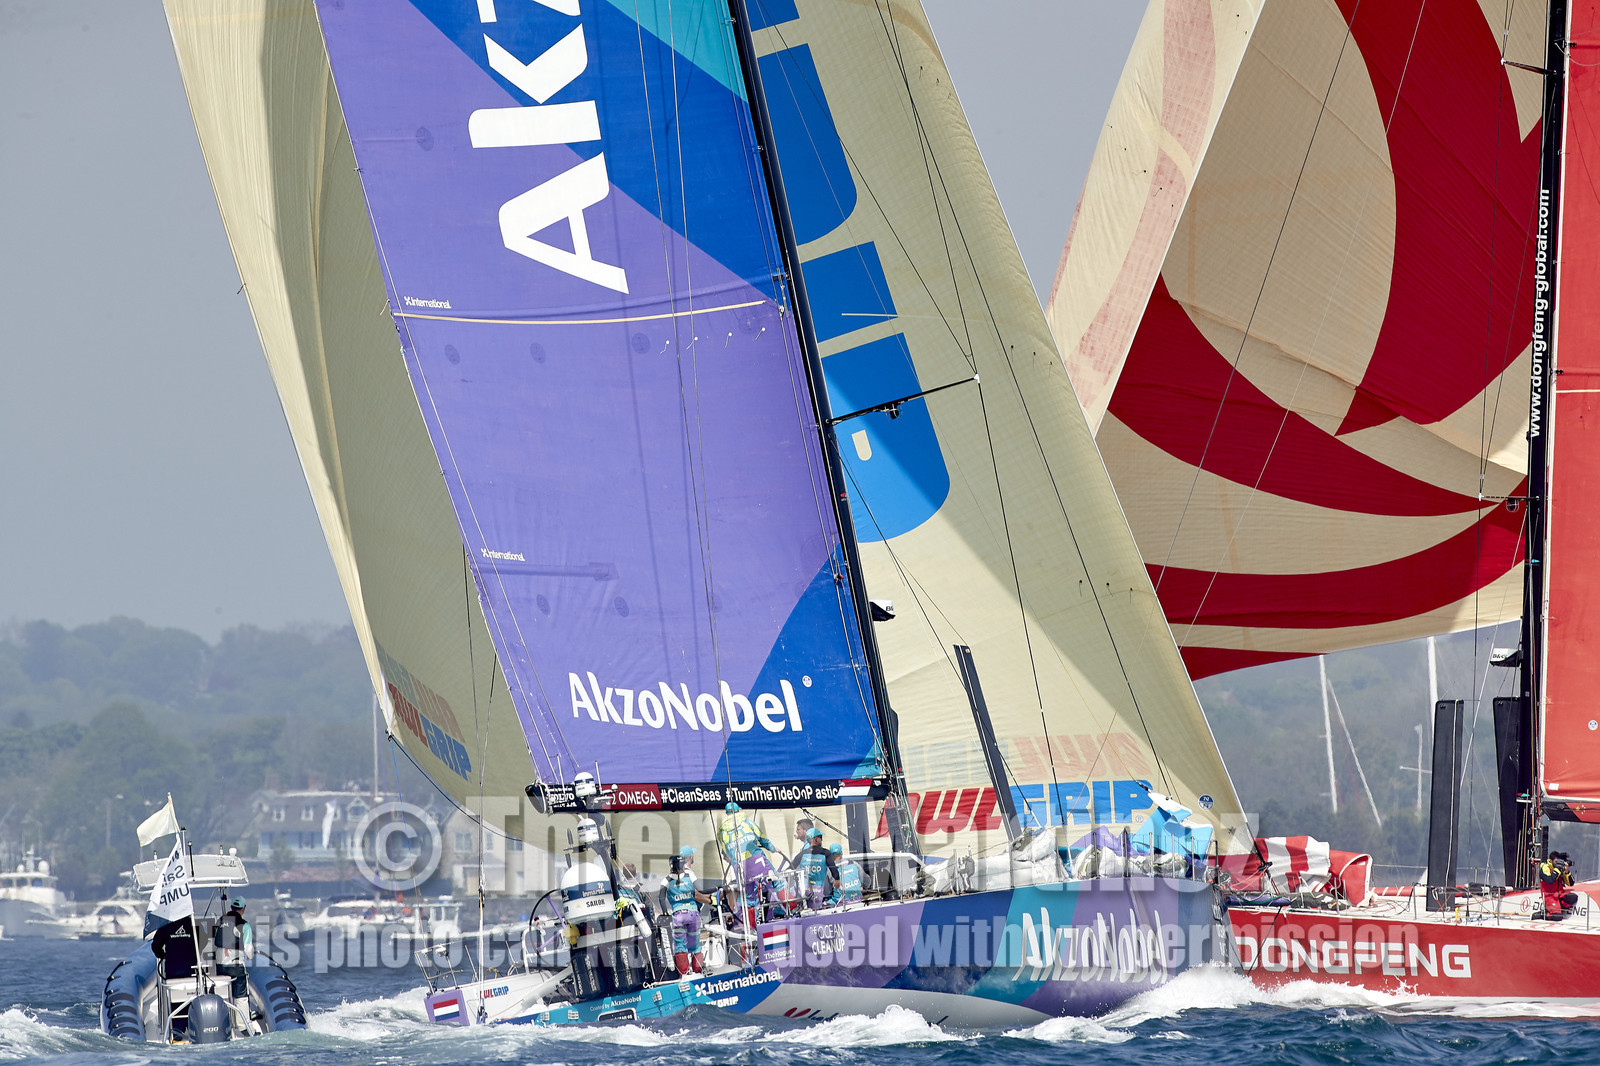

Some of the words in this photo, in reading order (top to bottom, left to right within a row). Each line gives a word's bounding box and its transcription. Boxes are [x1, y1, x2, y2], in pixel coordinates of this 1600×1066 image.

[1530, 188, 1550, 438] www.dongfeng-global.com
[568, 671, 803, 733] AkzoNobel
[619, 790, 658, 806] OMEGA
[660, 786, 722, 804] #CleanSeas
[586, 899, 605, 908] SAILOR
[817, 923, 845, 940] OCEAN
[811, 937, 846, 956] CLEANUP
[1011, 907, 1169, 985] AkzoNobel
[1234, 936, 1472, 978] DONGFENG
[705, 967, 781, 996] International
[611, 994, 642, 1007] AkzoNobel
